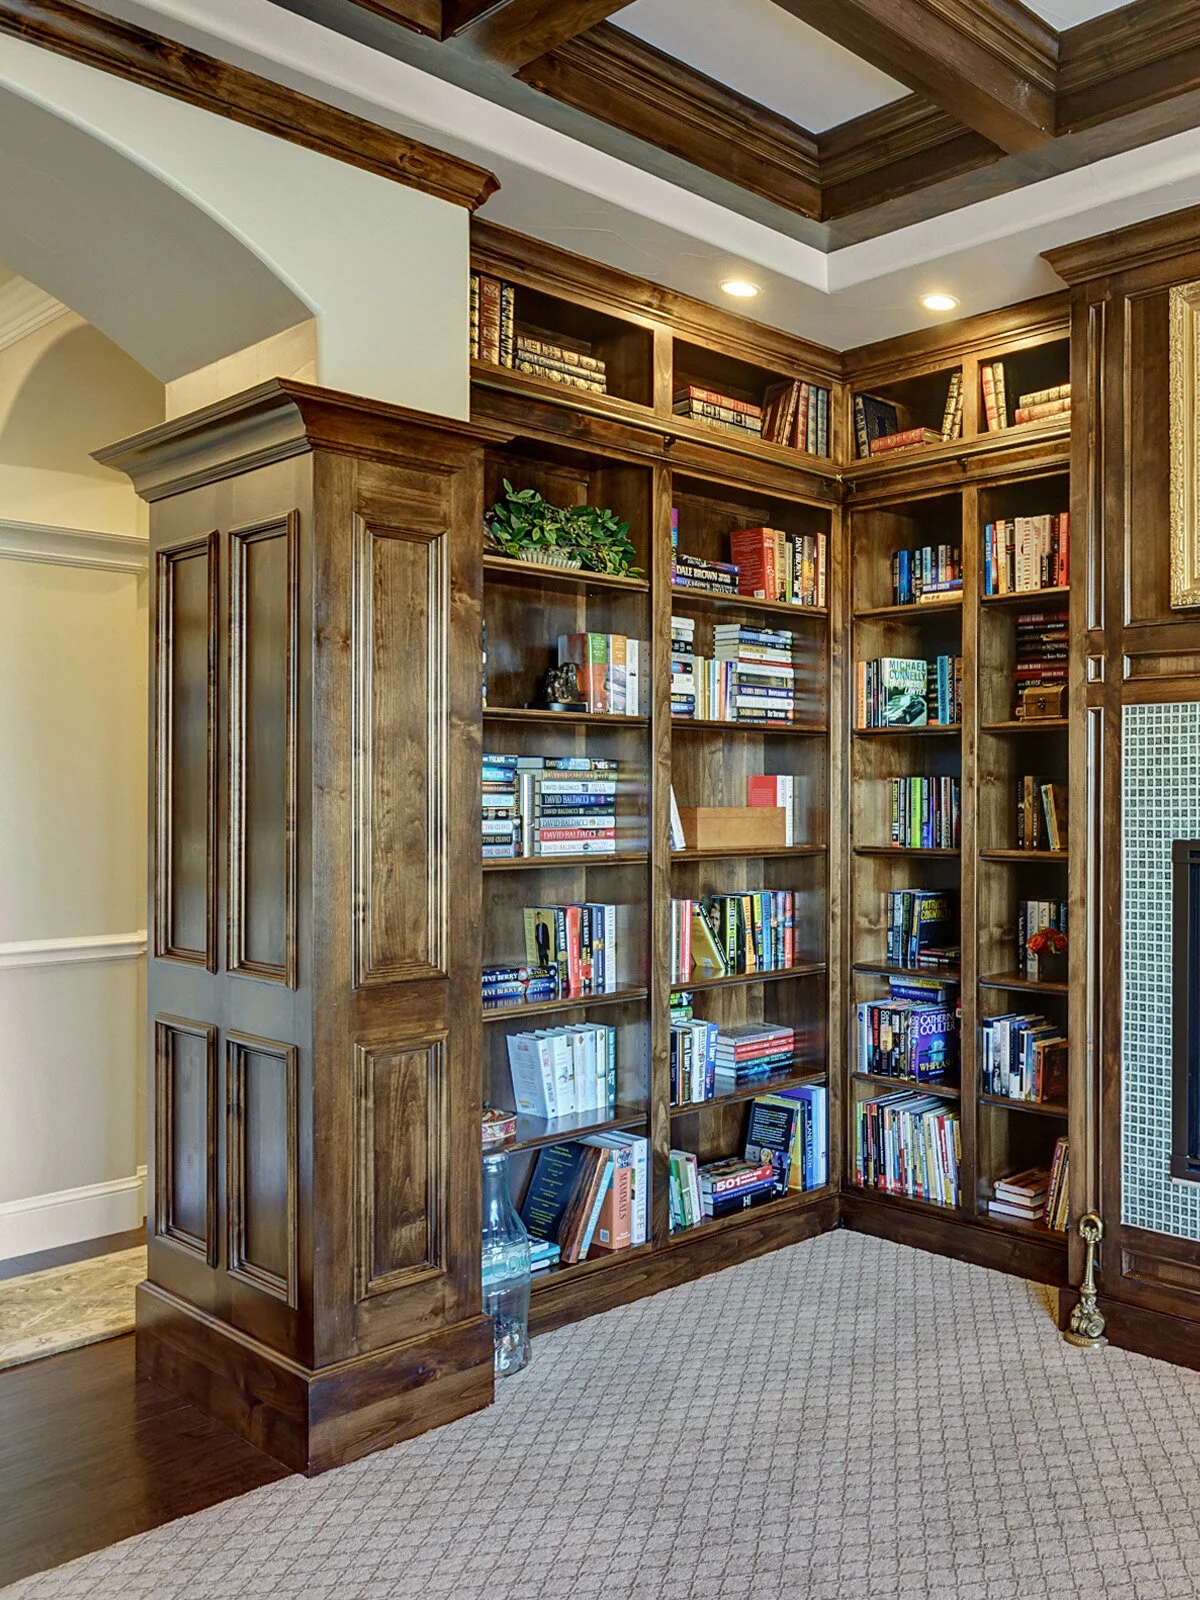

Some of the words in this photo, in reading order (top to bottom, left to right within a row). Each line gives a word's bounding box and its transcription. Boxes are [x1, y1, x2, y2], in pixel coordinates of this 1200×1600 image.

[795, 537, 803, 552] DAN
[676, 565, 693, 576] DALE
[693, 567, 718, 581] BROWN
[889, 660, 926, 672] MICHAEL
[889, 670, 926, 682] CONNELLY
[544, 796, 561, 804] DAVID
[562, 796, 590, 804] BALDACCI
[541, 819, 560, 827] DAVID
[560, 818, 589, 827] BALDACCI
[543, 831, 564, 839] DAVID
[564, 828, 597, 838] BALDACCI
[684, 1034, 692, 1050] Tom
[709, 1030, 717, 1043] Tom
[707, 1043, 717, 1062] Clancy
[682, 1050, 692, 1072] Clancy
[716, 1175, 741, 1192] 501
[618, 1172, 627, 1220] MAMMALS
